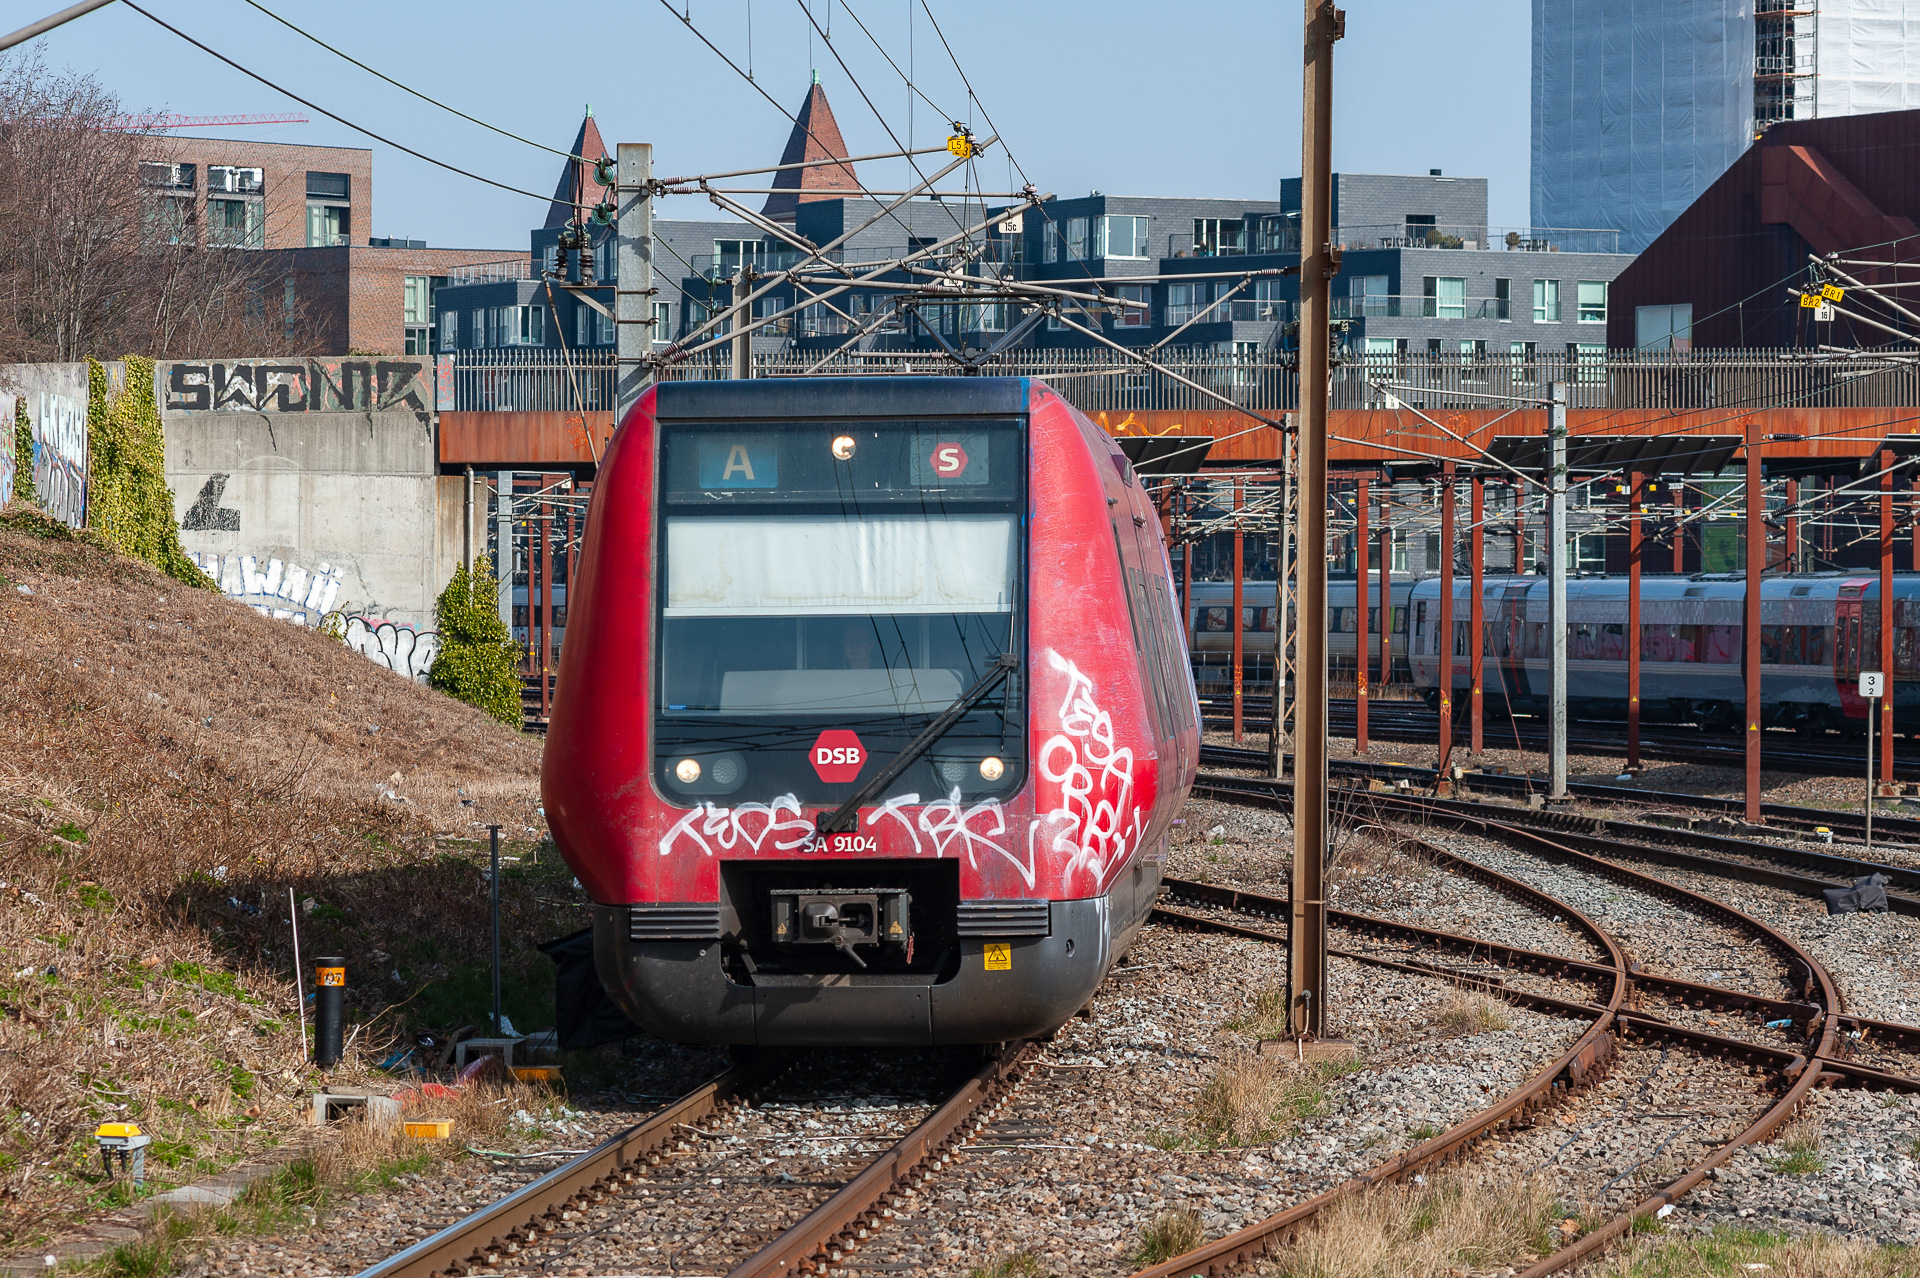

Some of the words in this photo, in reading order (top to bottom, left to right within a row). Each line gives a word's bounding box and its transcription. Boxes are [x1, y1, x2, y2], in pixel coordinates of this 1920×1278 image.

[951, 140, 962, 150] L5
[1005, 222, 1017, 232] 15c
[1823, 287, 1841, 300] BR1
[1803, 297, 1820, 307] BR2
[1821, 311, 1828, 320] 16
[722, 444, 756, 481] A
[938, 448, 960, 472] S
[1867, 676, 1876, 685] 3
[816, 747, 860, 765] DSB
[803, 836, 828, 853] SA
[834, 836, 877, 853] 9104
